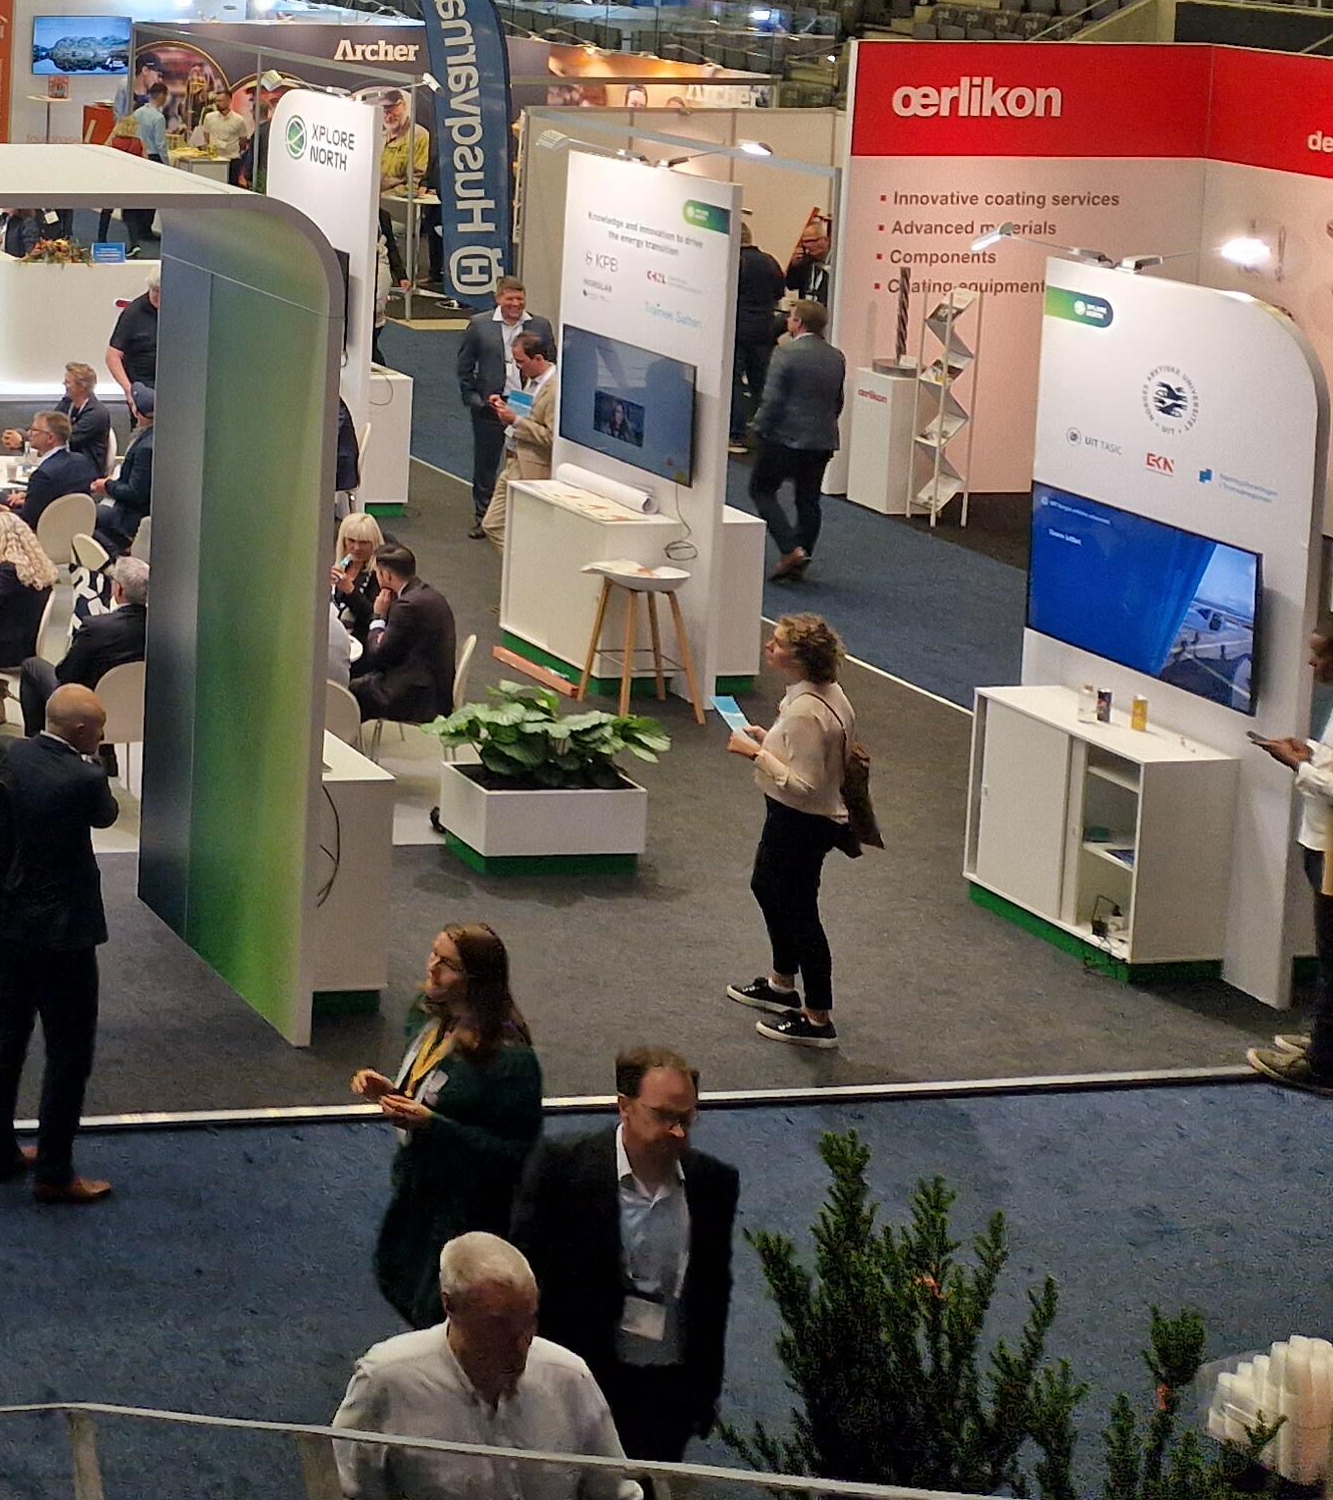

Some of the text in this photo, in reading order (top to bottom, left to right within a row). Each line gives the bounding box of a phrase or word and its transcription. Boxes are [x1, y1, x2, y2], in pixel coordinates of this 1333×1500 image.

[333, 39, 420, 62] Archer
[312, 124, 355, 151] XPLORE
[310, 145, 347, 172] NORTH
[893, 191, 1120, 209] Innovative coating services
[588, 211, 624, 228] Knowledge
[625, 221, 638, 231] and
[639, 224, 675, 241] innovation
[891, 220, 1057, 235] Advanced merials
[620, 233, 644, 248] energy
[595, 253, 618, 272] KPB
[889, 250, 997, 265] Components
[887, 279, 952, 296] Cating
